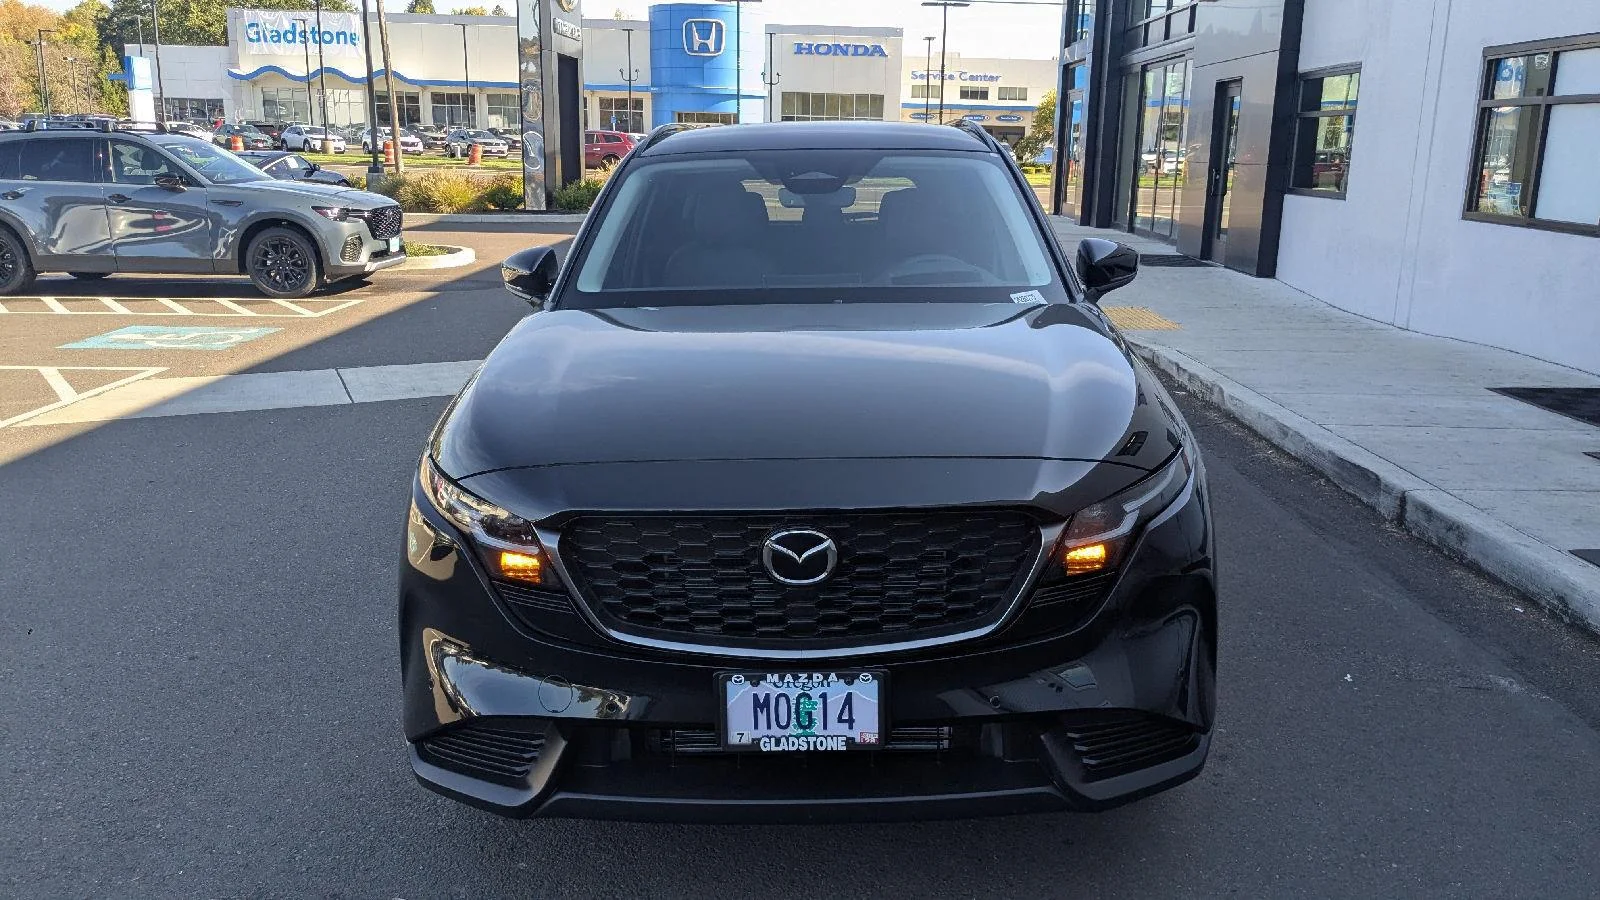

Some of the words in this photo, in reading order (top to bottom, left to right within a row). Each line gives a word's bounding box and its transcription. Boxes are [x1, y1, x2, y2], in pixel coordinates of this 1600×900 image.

[246, 22, 360, 46] Gladstone
[793, 42, 889, 58] HONDA
[910, 70, 956, 81] Service
[958, 71, 1002, 82] Center
[766, 672, 838, 683] MAZDA
[736, 732, 745, 743] 7
[759, 736, 847, 751] GLADSTONE
